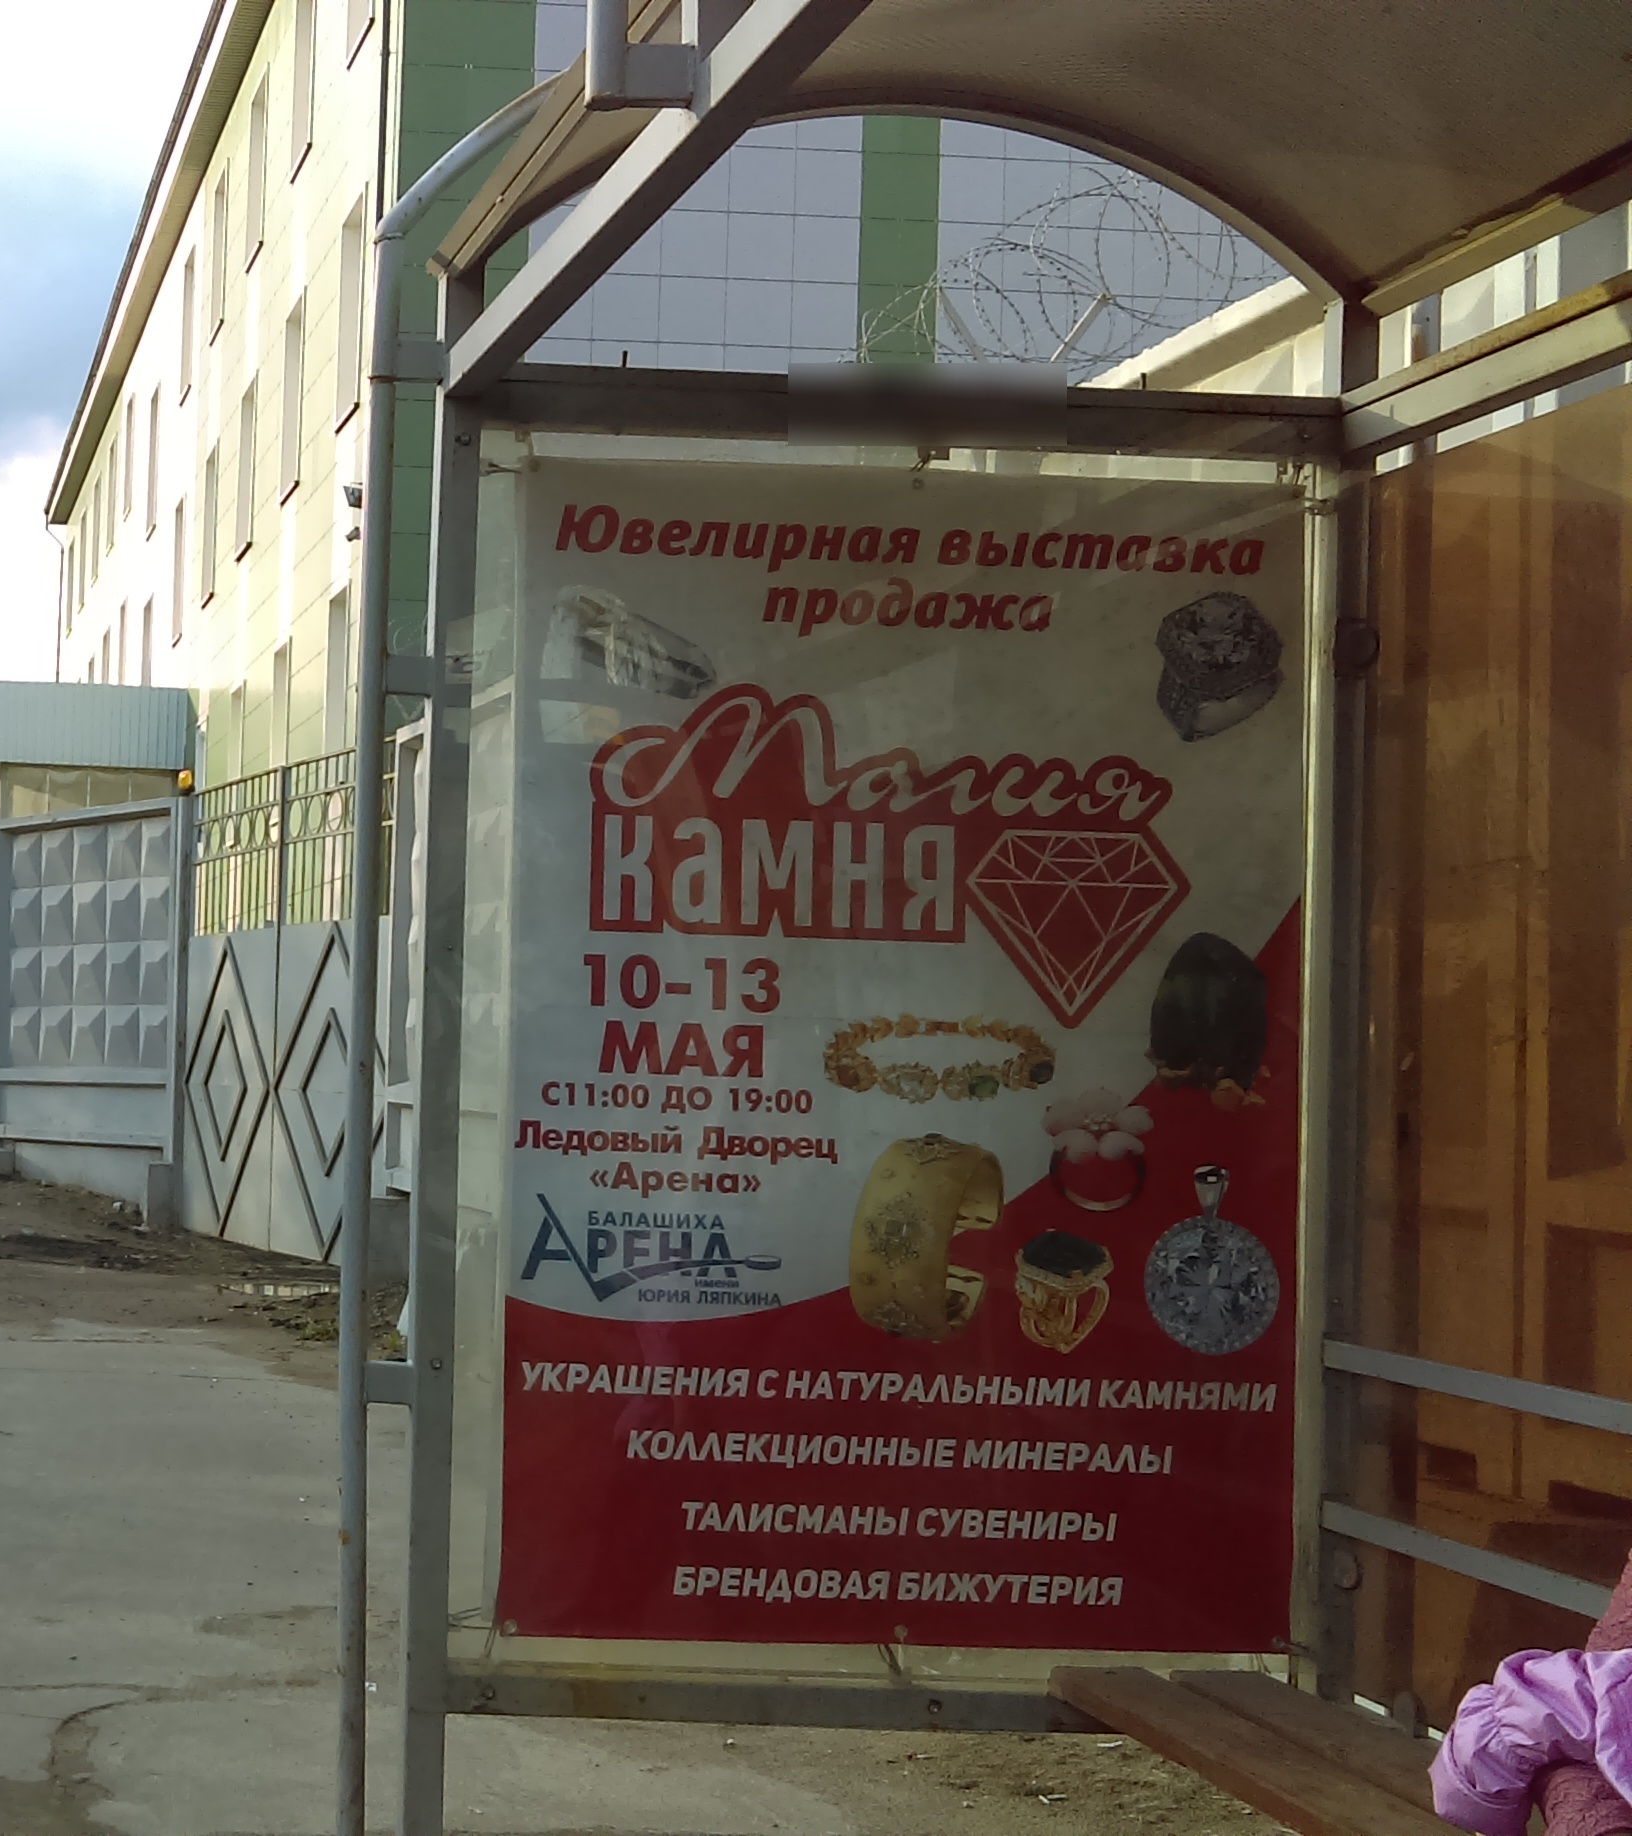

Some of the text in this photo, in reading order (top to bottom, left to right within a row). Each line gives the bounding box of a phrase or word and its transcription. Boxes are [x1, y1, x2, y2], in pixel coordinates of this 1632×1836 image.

[555, 503, 1266, 576] Ювелирная выставка
[762, 576, 1055, 638] продажа
[582, 953, 781, 1014] 10-13
[598, 1019, 765, 1079] МАЯ
[660, 1084, 713, 1115] ДО
[728, 1086, 814, 1115] 19:00
[514, 1119, 839, 1165] Ледовый Дворец
[588, 1160, 762, 1199] «Арена»
[587, 1209, 726, 1231] БАЛАШИХА
[637, 1288, 783, 1308] ЮРИЯ ЛЯПКИНА
[520, 1361, 1278, 1413] УКРАШЕНИЯ С НАТУРАЛЬНЫМИ КАМНЯМИ
[626, 1429, 1174, 1475] КОЛЛЕКЦИОННЫЕ МИНЕРАЛЫ
[681, 1501, 1118, 1543] ТАЛИСМАНЫ СУВЕНИРЫ
[672, 1565, 1124, 1607] БРЕНДОВАЯ БИЖУТЕРИЯ
